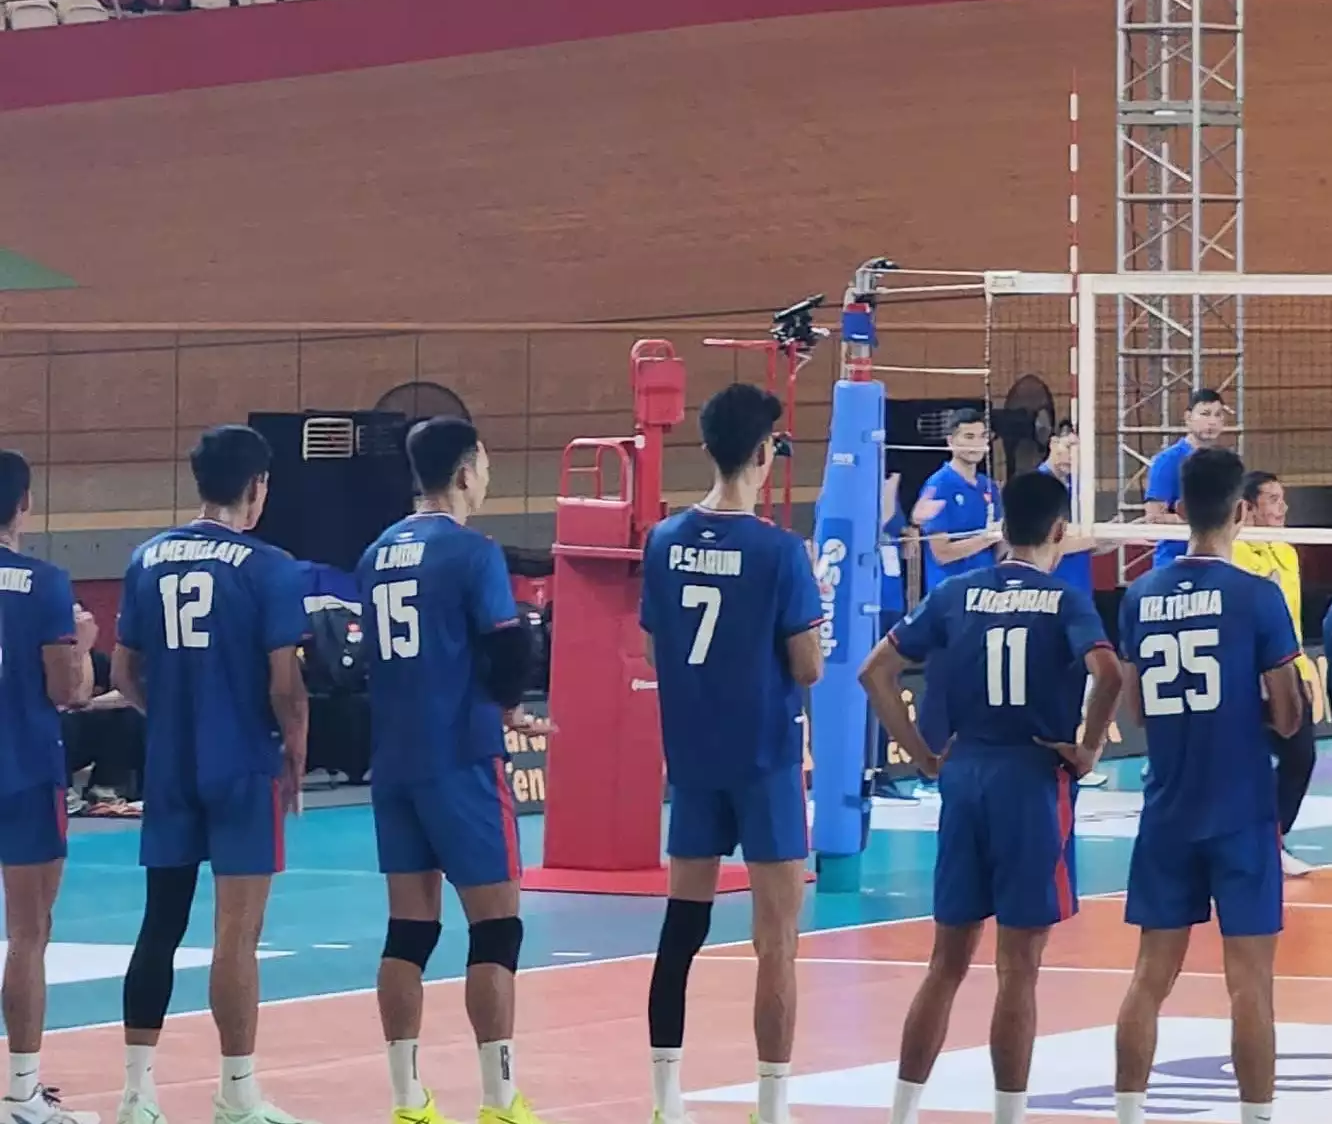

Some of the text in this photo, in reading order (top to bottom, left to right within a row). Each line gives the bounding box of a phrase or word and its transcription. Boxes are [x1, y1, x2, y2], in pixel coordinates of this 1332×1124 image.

[159, 572, 214, 649] 12
[372, 579, 420, 660] 15
[682, 585, 721, 664] 7
[986, 627, 1028, 706] 11
[1140, 629, 1221, 716] 25
